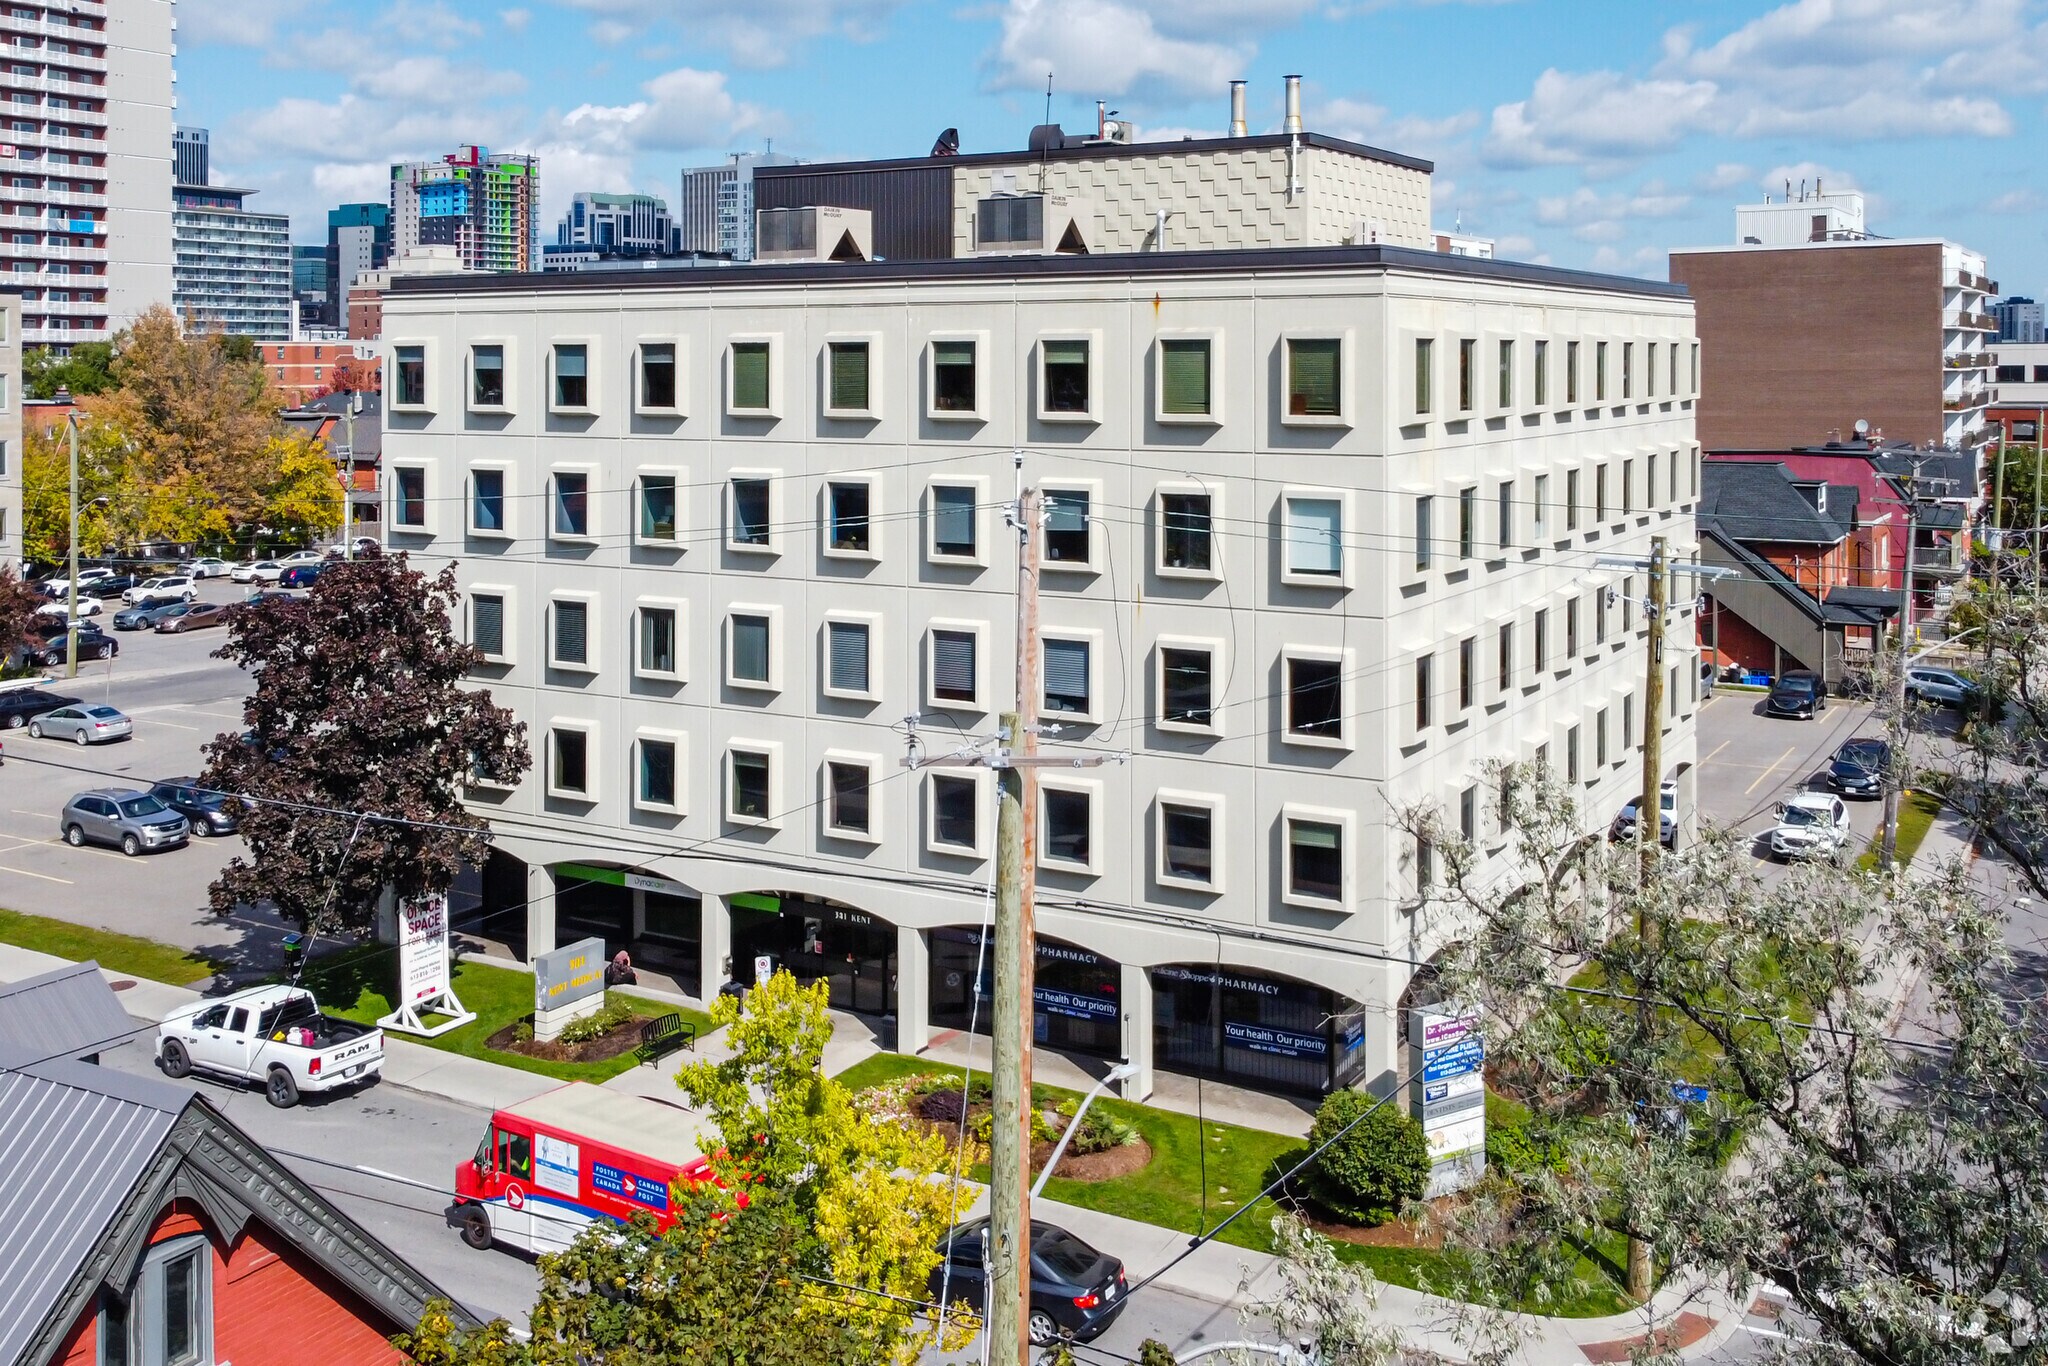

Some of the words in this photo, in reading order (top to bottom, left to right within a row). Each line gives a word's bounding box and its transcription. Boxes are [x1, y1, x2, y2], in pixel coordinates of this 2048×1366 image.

[408, 913, 441, 935] SPACE
[851, 914, 871, 925] KENT
[1042, 946, 1098, 964] PHARMACY
[1218, 977, 1279, 995] PHARMACY
[1033, 991, 1044, 1000] our
[1045, 993, 1070, 1006] health
[1073, 997, 1087, 1009] Our
[1088, 1000, 1118, 1016] priority
[1225, 1024, 1245, 1036] Your
[1246, 1028, 1273, 1042] health
[1276, 1033, 1293, 1045] Our
[1294, 1038, 1327, 1053] priority
[335, 1043, 370, 1061] RAM
[595, 1165, 618, 1178] POSTES
[595, 1178, 621, 1191] CANADA
[638, 1180, 664, 1193] CANADA
[638, 1192, 654, 1202] POST
